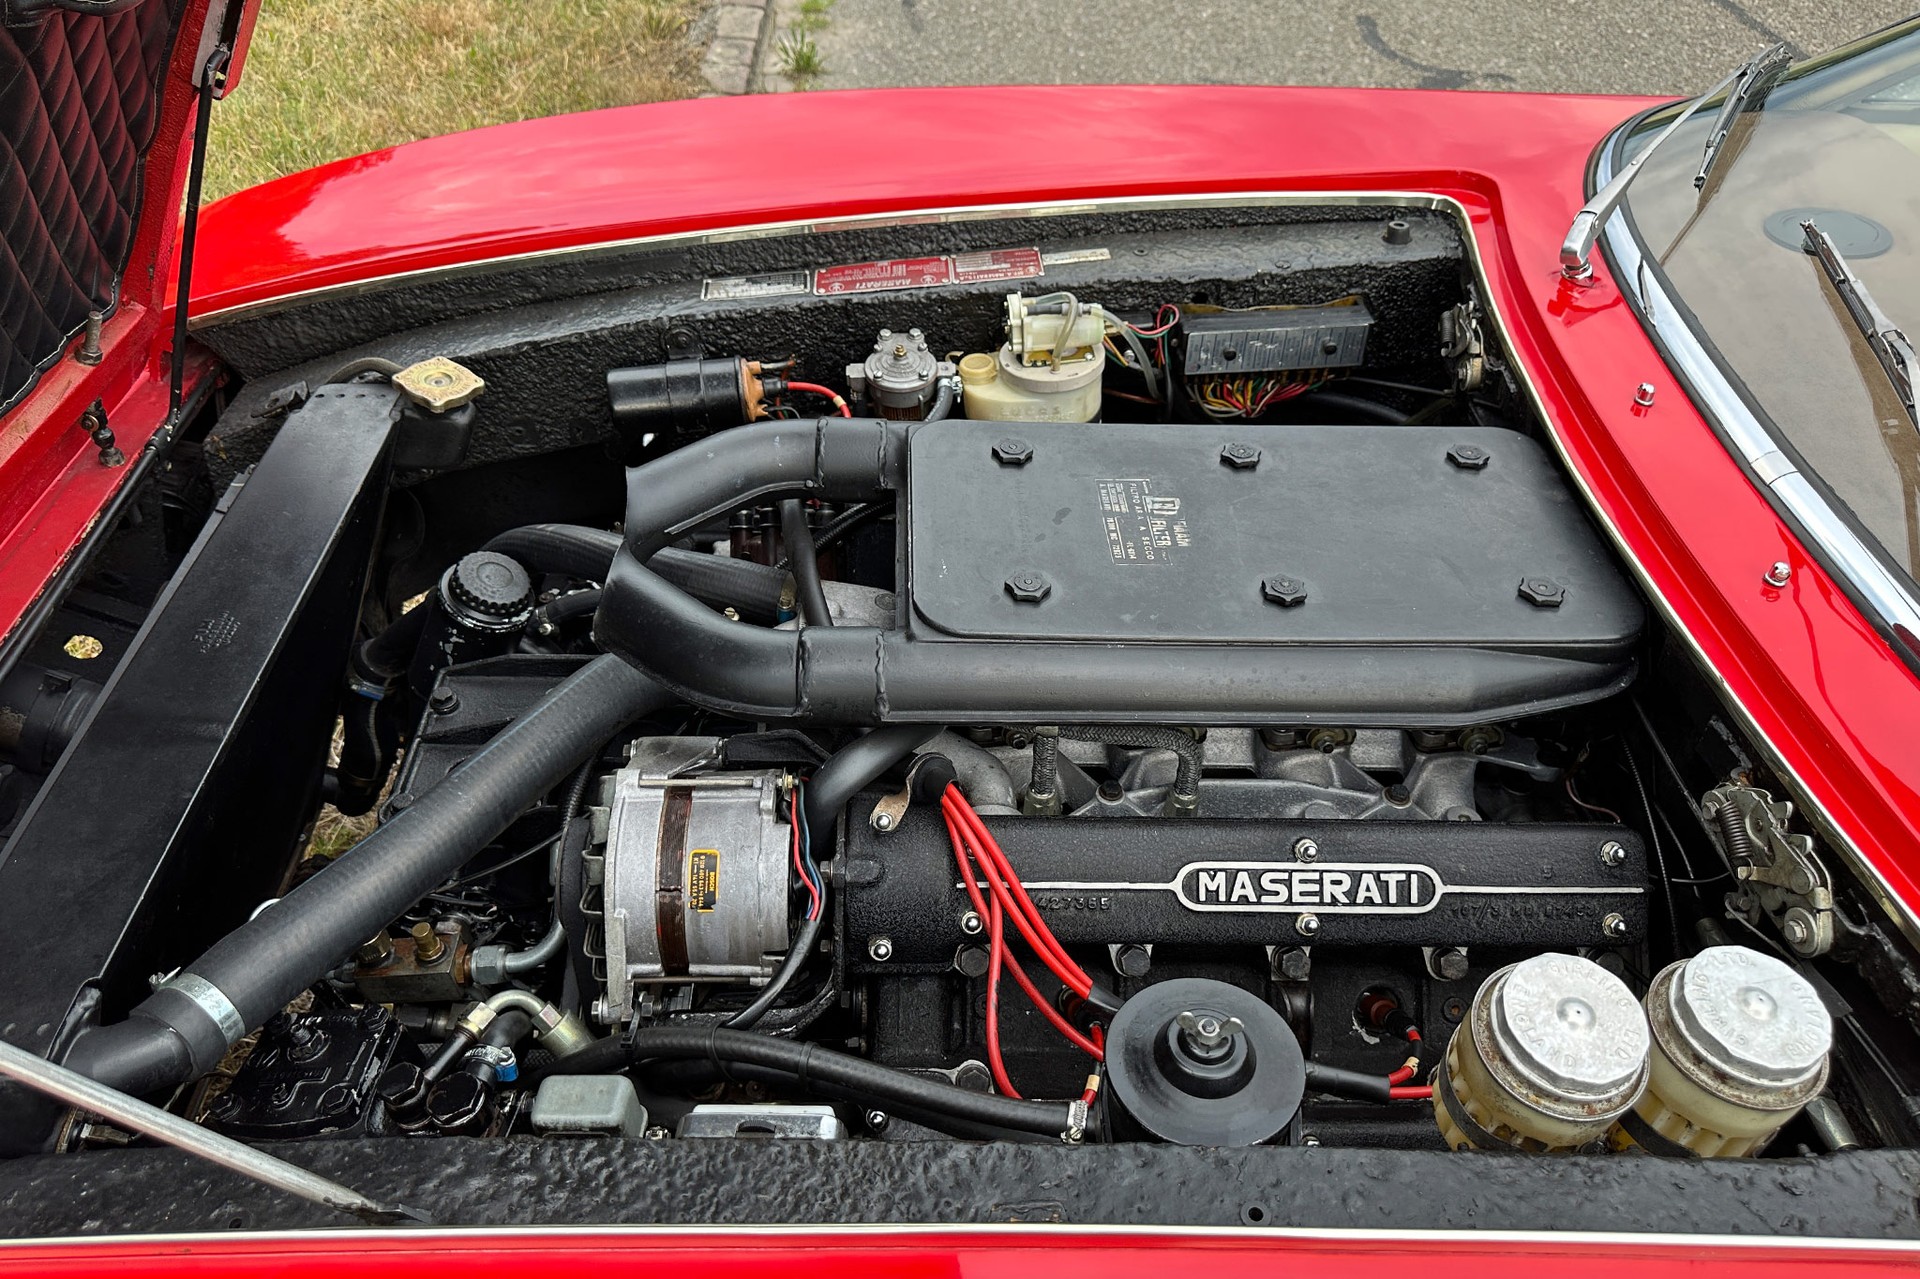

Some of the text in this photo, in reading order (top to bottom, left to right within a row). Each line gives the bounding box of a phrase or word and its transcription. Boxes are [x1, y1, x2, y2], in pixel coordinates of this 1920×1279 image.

[856, 279, 911, 289] MASERATI
[1130, 483, 1141, 504] FILTRO
[1142, 537, 1155, 560] SECCO
[1150, 520, 1171, 546] FILTER
[1199, 870, 1418, 904] MASERATI
[1511, 983, 1576, 1068] ENGLAND
